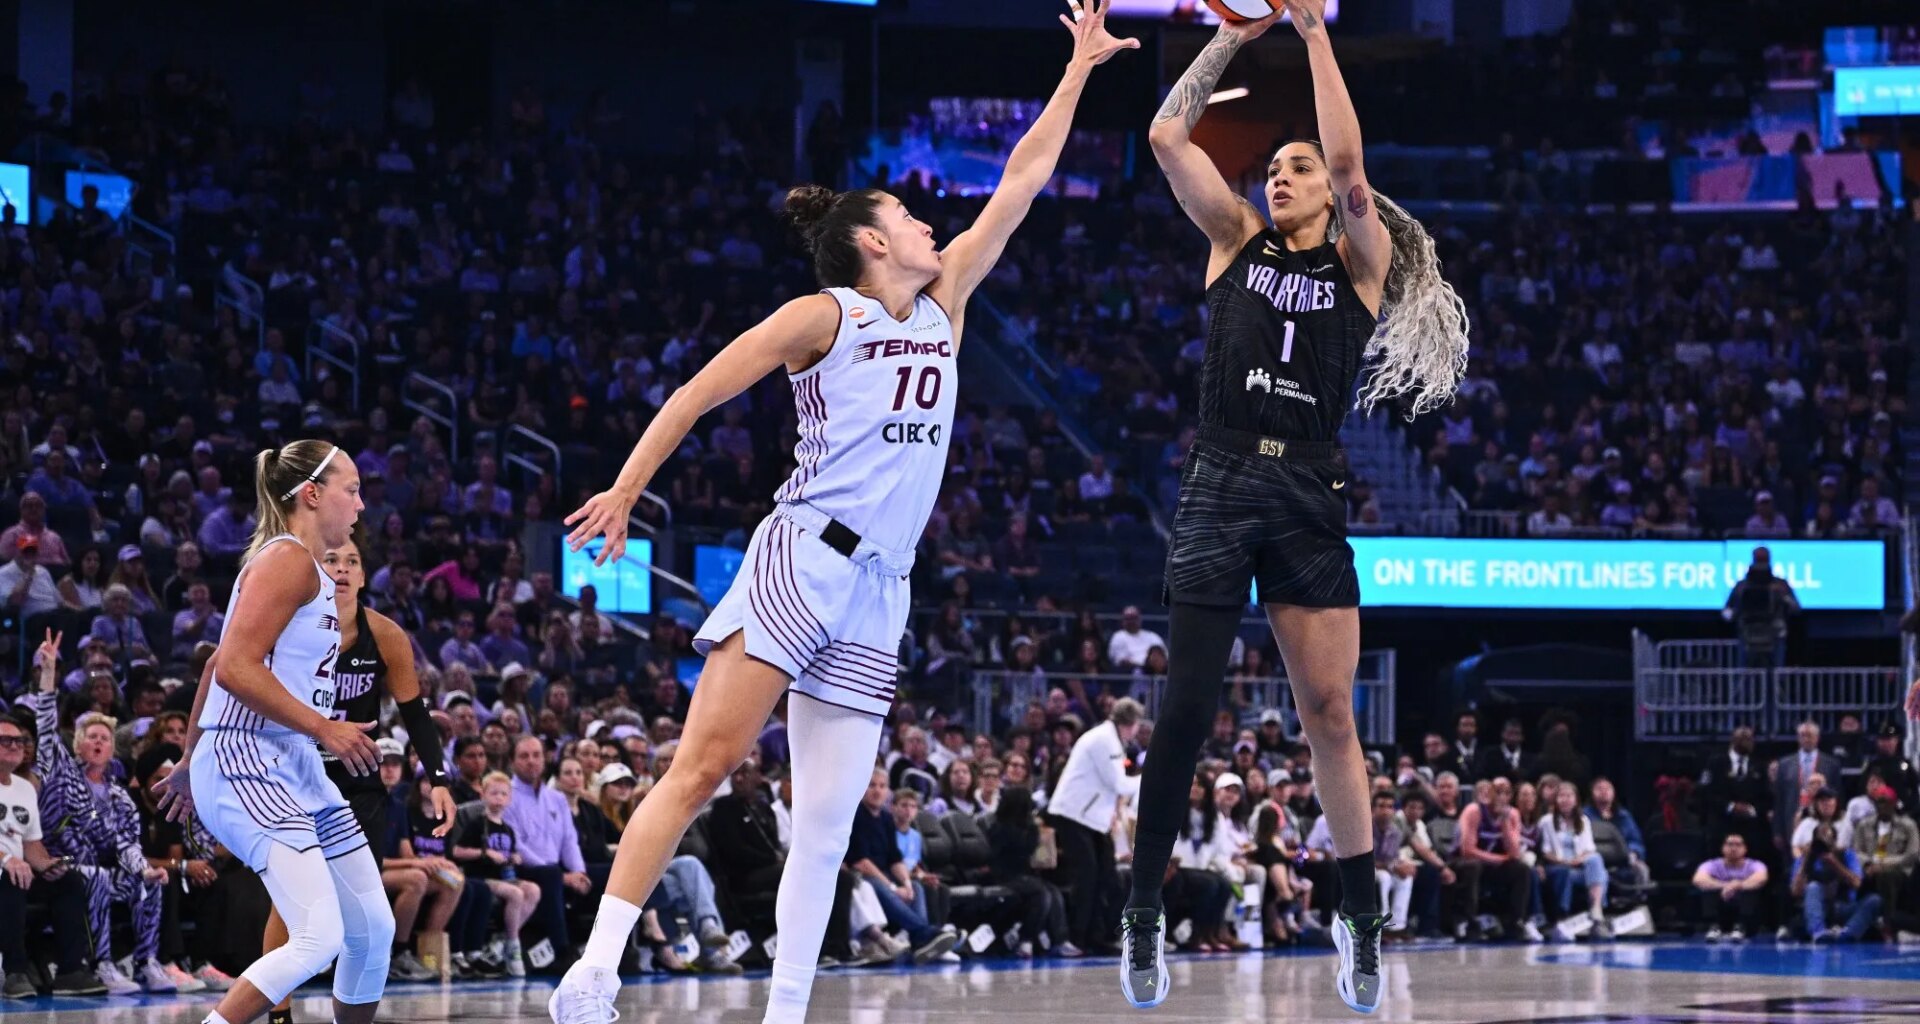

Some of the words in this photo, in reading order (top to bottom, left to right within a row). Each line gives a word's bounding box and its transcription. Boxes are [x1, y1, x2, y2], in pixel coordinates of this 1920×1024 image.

[1246, 263, 1335, 312] VALKYRIES
[851, 339, 951, 363] TEMPO
[1281, 320, 1295, 363] 1
[892, 366, 941, 411] 10
[1275, 377, 1300, 390] KAISER
[882, 422, 926, 443] CIBC
[1259, 440, 1285, 457] GSV
[1374, 558, 1415, 586] ON
[1422, 559, 1477, 588] THE
[1485, 560, 1656, 589] FRONTLINES
[1663, 561, 1716, 589] FOR
